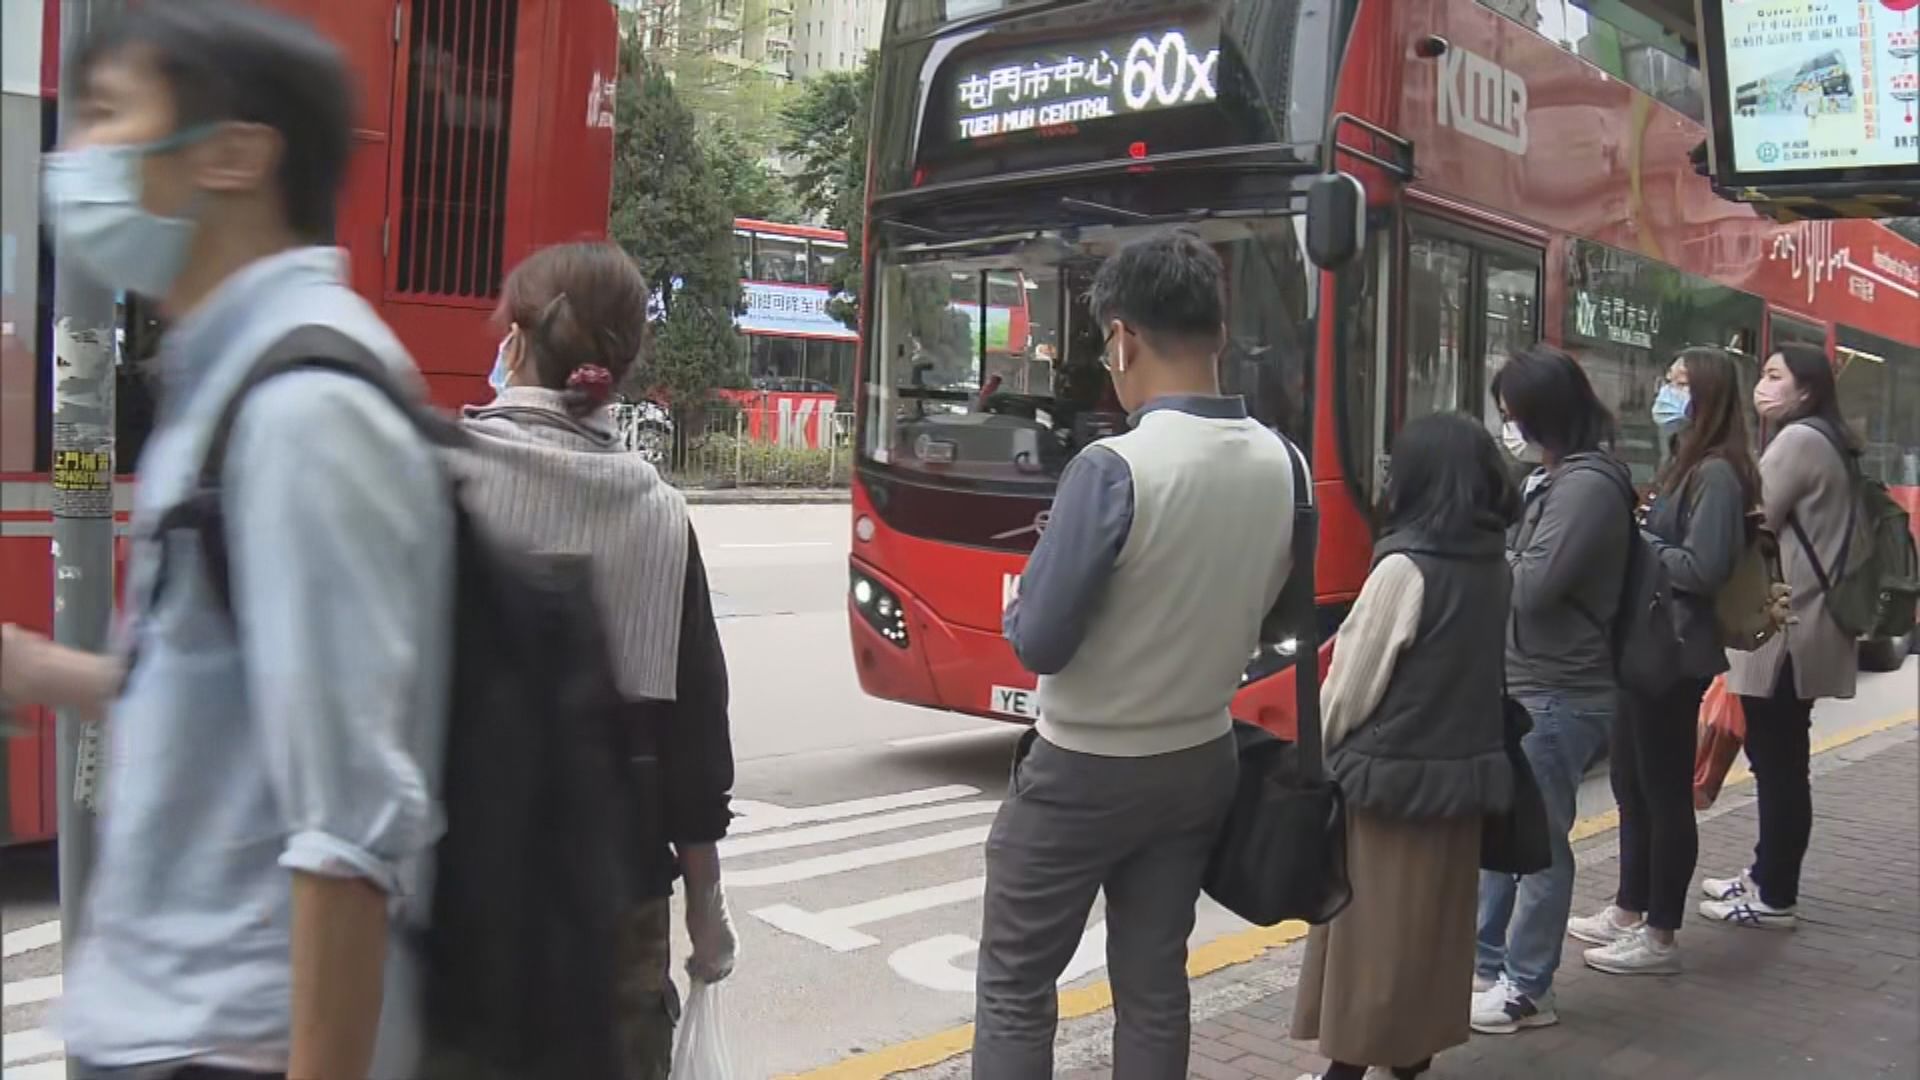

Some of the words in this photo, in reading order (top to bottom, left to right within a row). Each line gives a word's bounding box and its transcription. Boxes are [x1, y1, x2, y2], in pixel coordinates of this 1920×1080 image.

[958, 50, 1119, 109] 屯門市中心
[1437, 45, 1528, 155] KMB
[959, 113, 999, 139] TUEN
[1001, 107, 1035, 132] MUN
[1039, 96, 1114, 126] CENTRAL
[1001, 689, 1028, 714] YE
